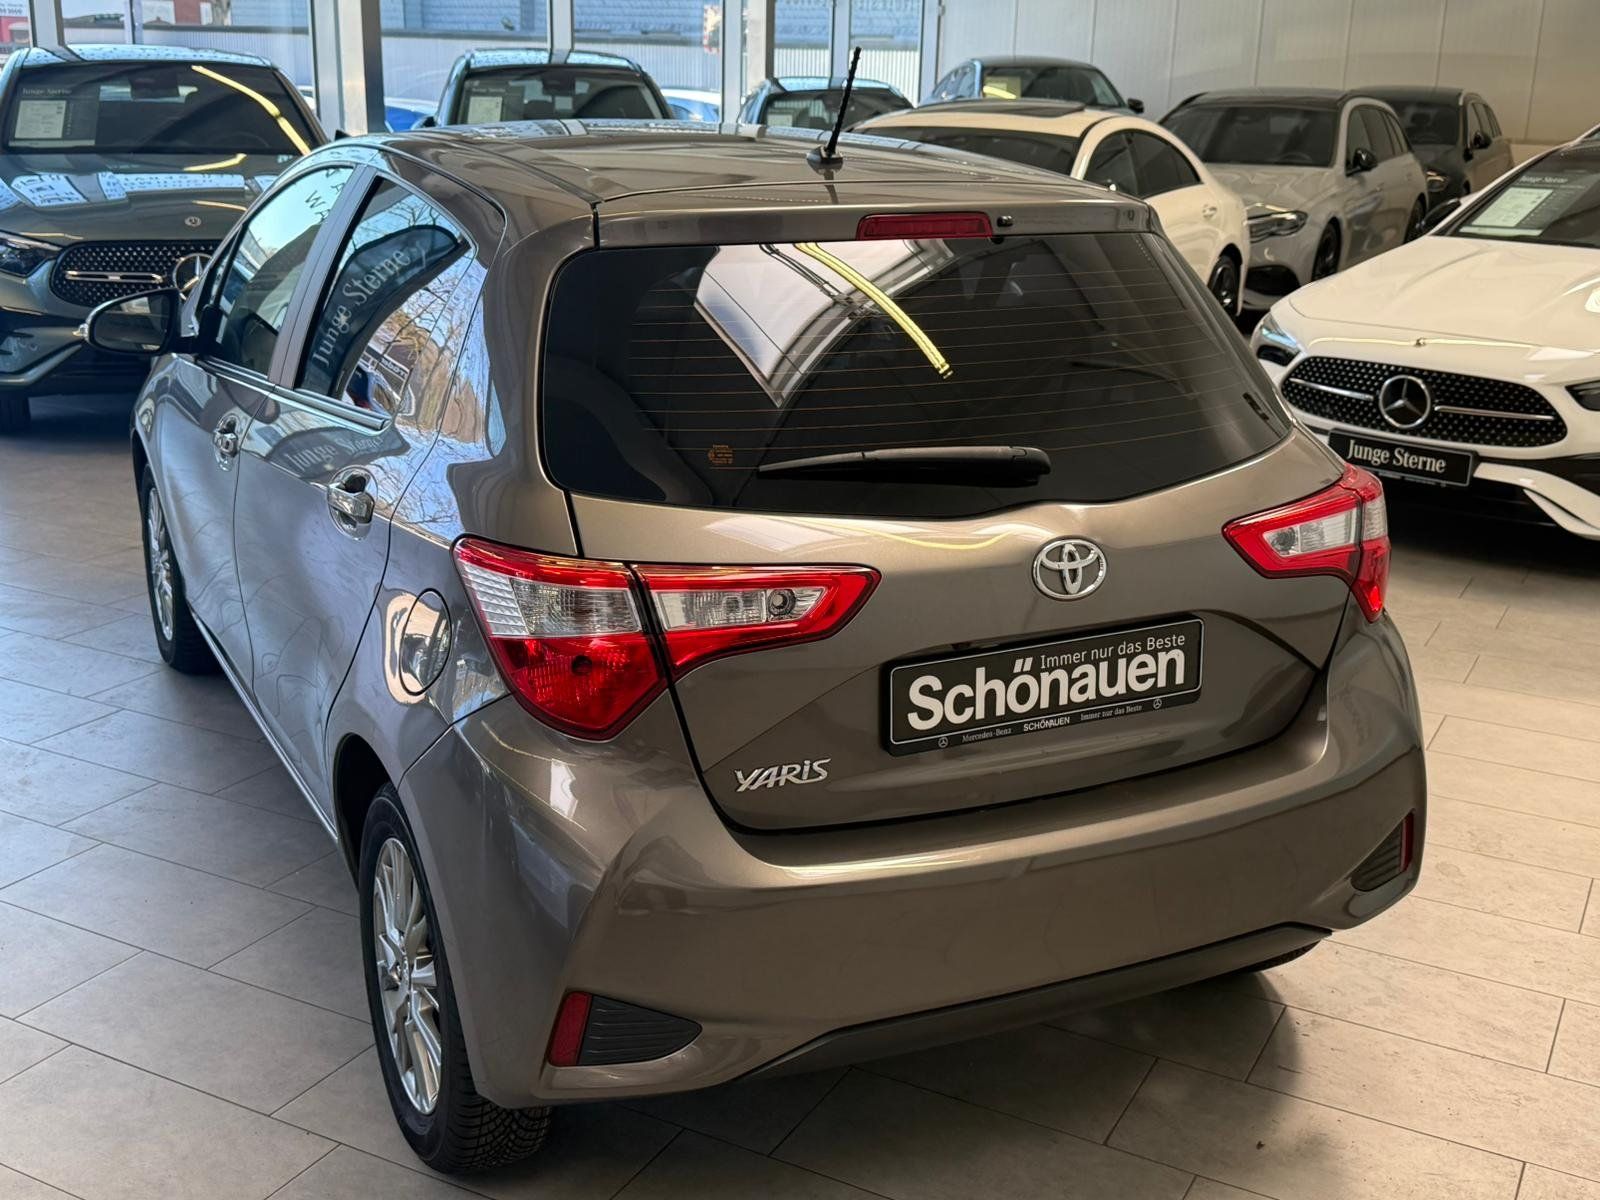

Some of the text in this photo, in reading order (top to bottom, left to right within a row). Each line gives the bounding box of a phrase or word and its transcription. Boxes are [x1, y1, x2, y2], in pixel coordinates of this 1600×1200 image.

[312, 305, 353, 367] Junge
[343, 249, 413, 307] Sterne
[1347, 439, 1446, 474] Junge Sterne
[1040, 634, 1186, 669] Immer nur das Beste
[907, 648, 1186, 731] Schönauen
[961, 727, 1012, 743] Mercedes-Benz
[1023, 716, 1071, 732] SCHÖNAUEN
[1080, 711, 1101, 721] Immer
[1114, 707, 1125, 715] das
[1125, 704, 1143, 713] Beste
